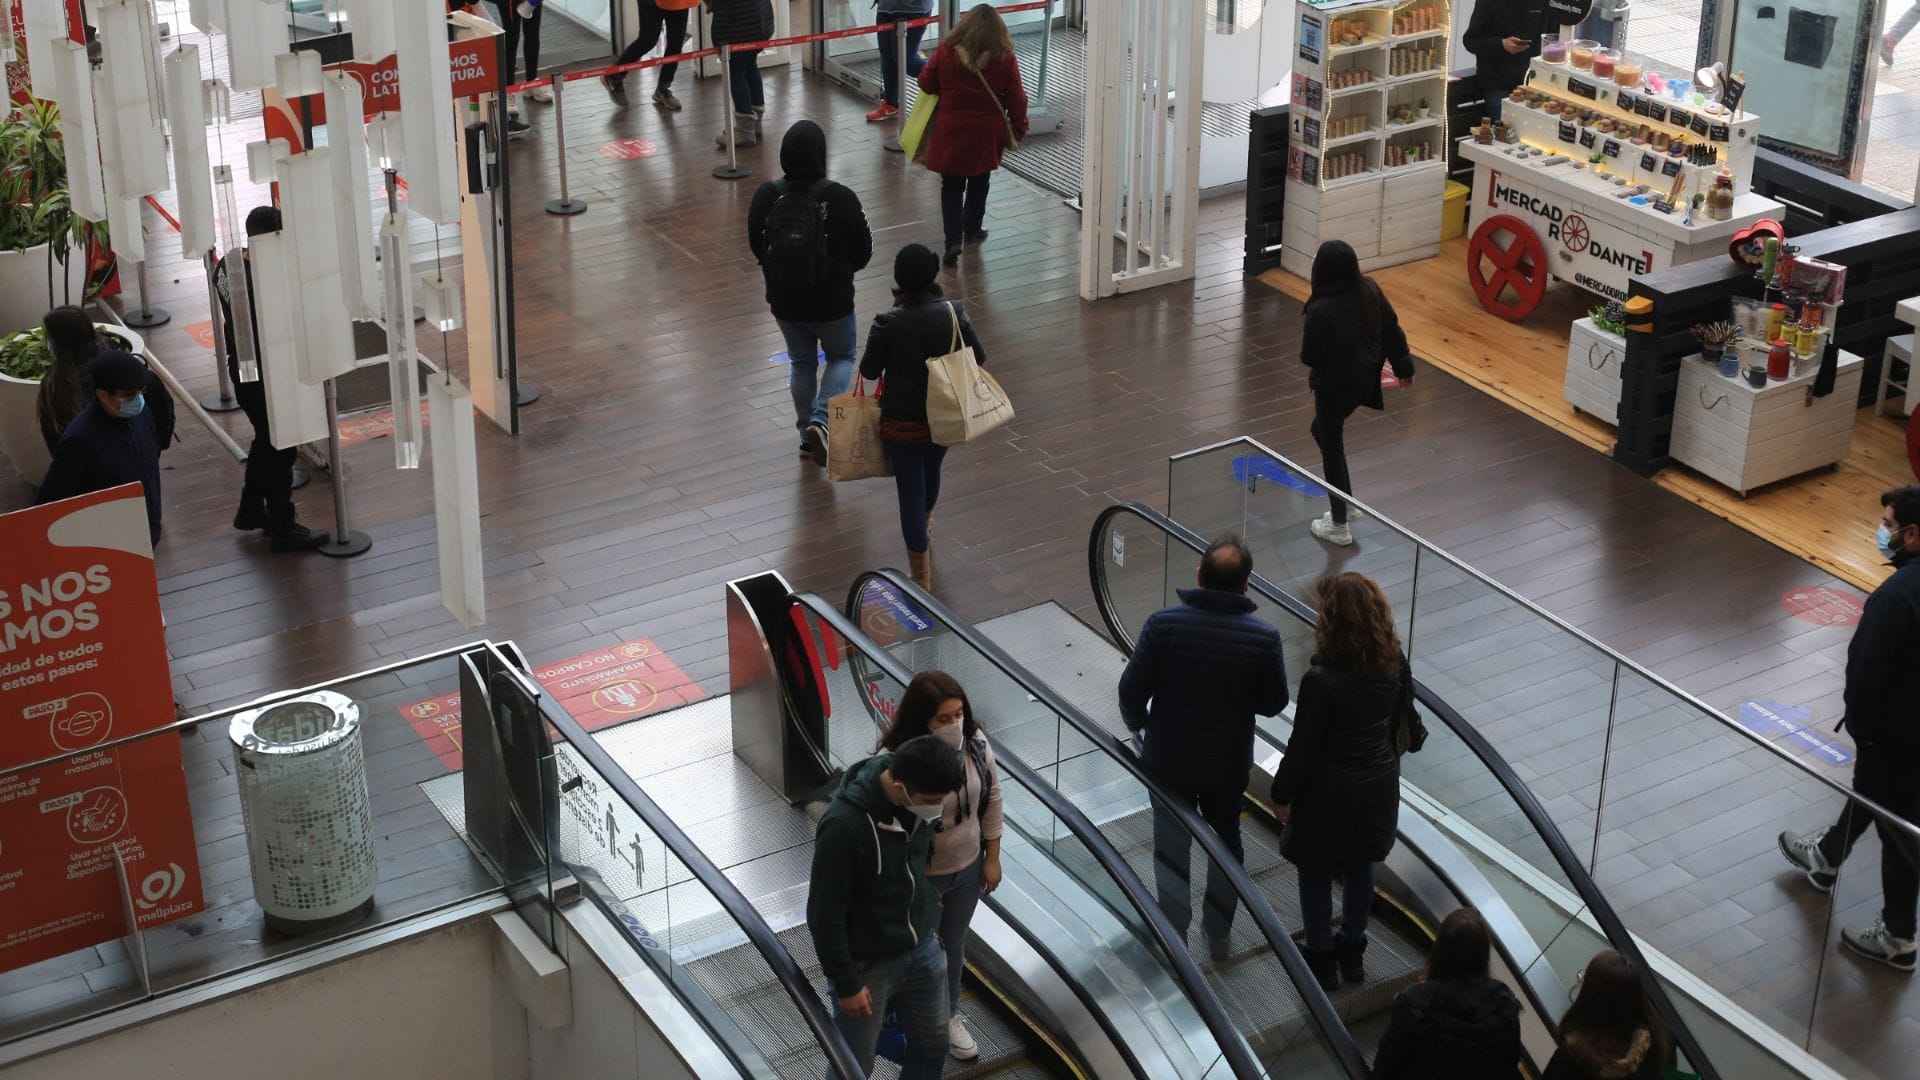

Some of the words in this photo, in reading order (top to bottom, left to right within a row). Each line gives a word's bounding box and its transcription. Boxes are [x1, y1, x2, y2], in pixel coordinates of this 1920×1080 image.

[835, 407, 846, 420] R
[20, 564, 111, 612] NOS
[34, 653, 55, 667] de
[58, 641, 104, 661] todos
[594, 653, 617, 665] NO
[2, 671, 46, 691] estos
[49, 658, 99, 683] pasos:
[28, 703, 54, 716] PASO
[57, 700, 64, 709] 2
[71, 753, 93, 765] Usar
[94, 750, 104, 760] tu
[64, 757, 113, 776] mascarilla
[28, 777, 41, 788] de
[44, 797, 70, 811] PASO
[70, 850, 92, 861] Usar
[93, 846, 103, 856] el
[67, 860, 83, 873] gel
[83, 855, 102, 868] que
[0, 869, 23, 882] ntrol
[137, 901, 193, 923] mallplaza
